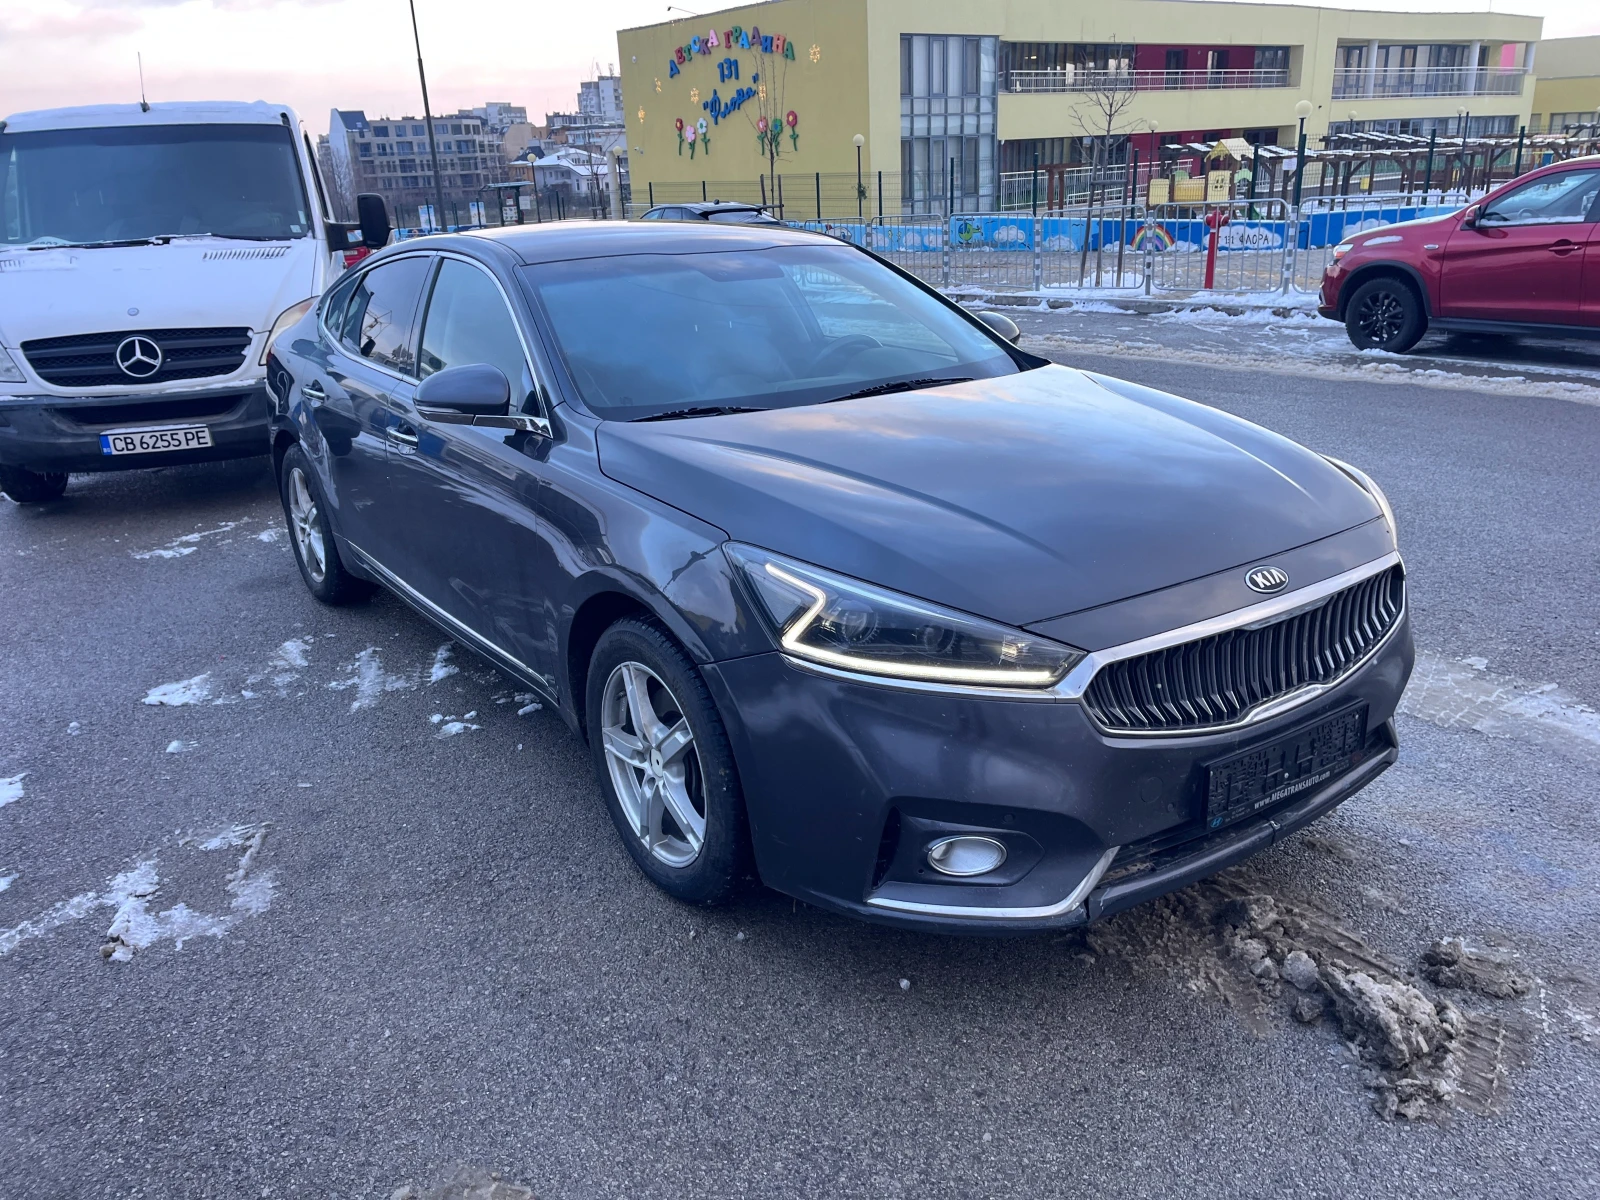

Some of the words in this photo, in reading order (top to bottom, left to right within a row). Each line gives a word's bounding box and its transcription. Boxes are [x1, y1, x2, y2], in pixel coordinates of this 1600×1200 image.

[669, 29, 720, 78] ДЕТСКА
[717, 58, 739, 83] 131
[112, 436, 136, 453] CB
[139, 432, 182, 450] 6255
[184, 430, 208, 447] PE
[1251, 568, 1286, 588] KIA
[1254, 770, 1331, 809] www.MEGATRANSAUTO.com
